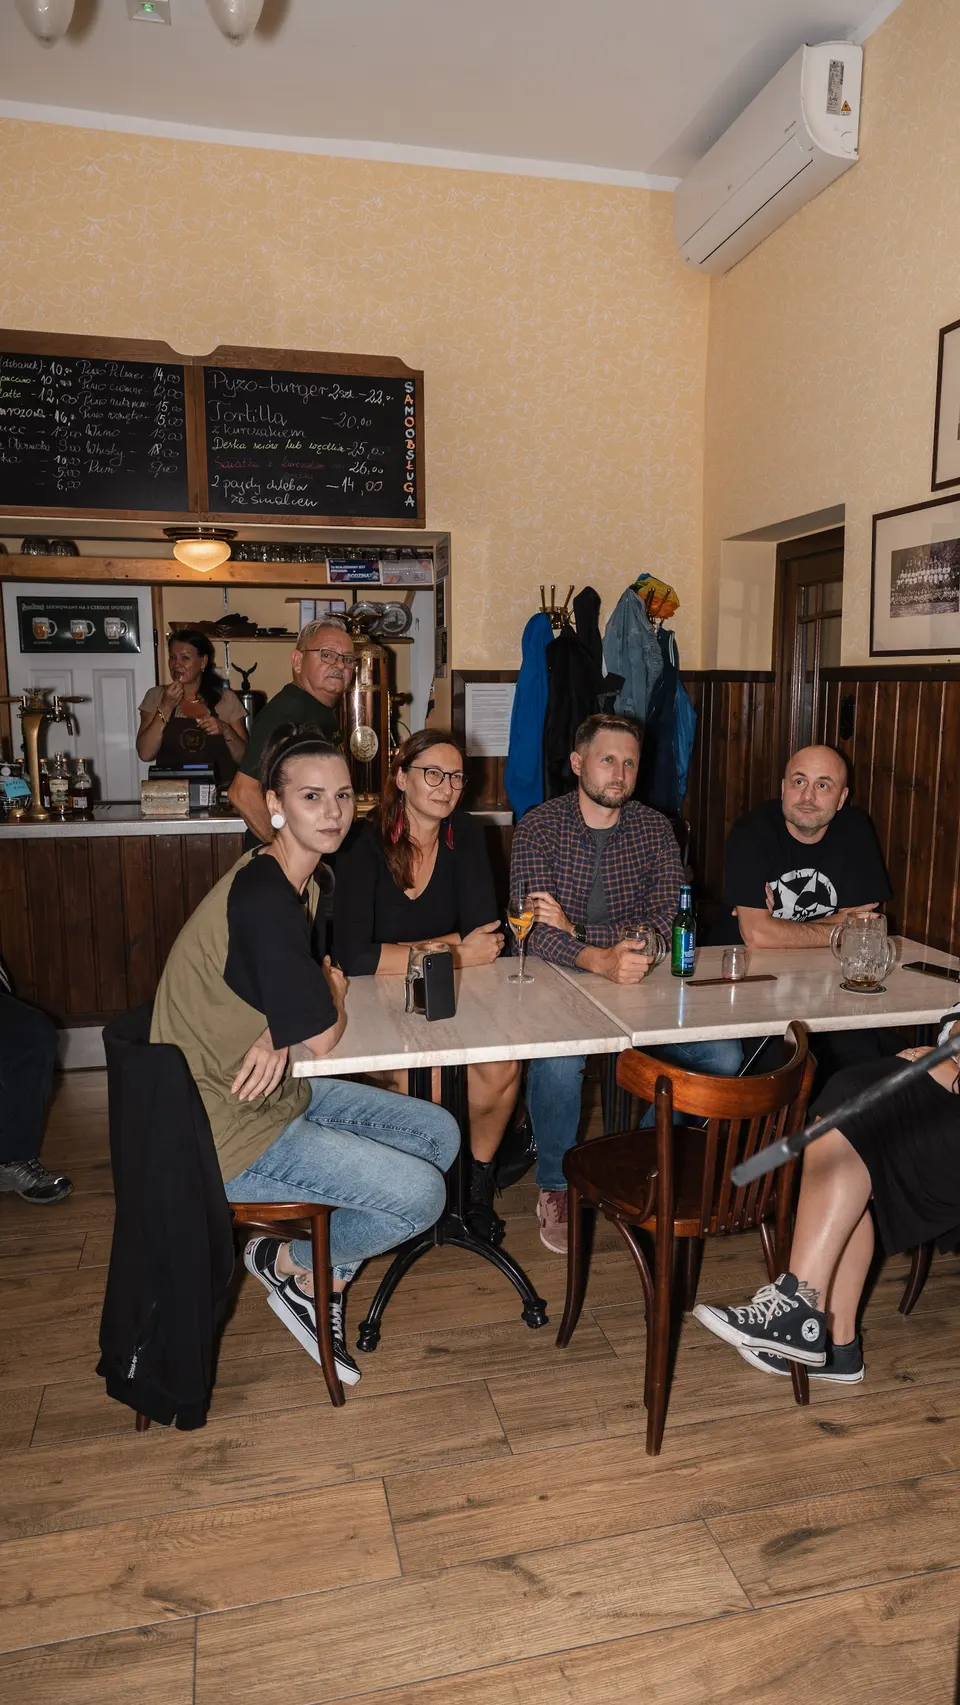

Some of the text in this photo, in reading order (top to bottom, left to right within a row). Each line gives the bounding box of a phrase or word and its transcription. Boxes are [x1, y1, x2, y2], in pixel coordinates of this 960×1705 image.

[207, 400, 288, 426] Tortilla
[85, 423, 121, 437] Wino
[223, 424, 306, 438] kurczakiem
[212, 436, 247, 450] Deska
[285, 439, 303, 450] lub
[403, 382, 415, 507] SAMOOBSŁUGA
[86, 440, 126, 467] Whisky
[84, 459, 117, 474] Rum
[210, 474, 220, 488] 2
[222, 477, 262, 498] pajdy
[231, 495, 249, 506] ze
